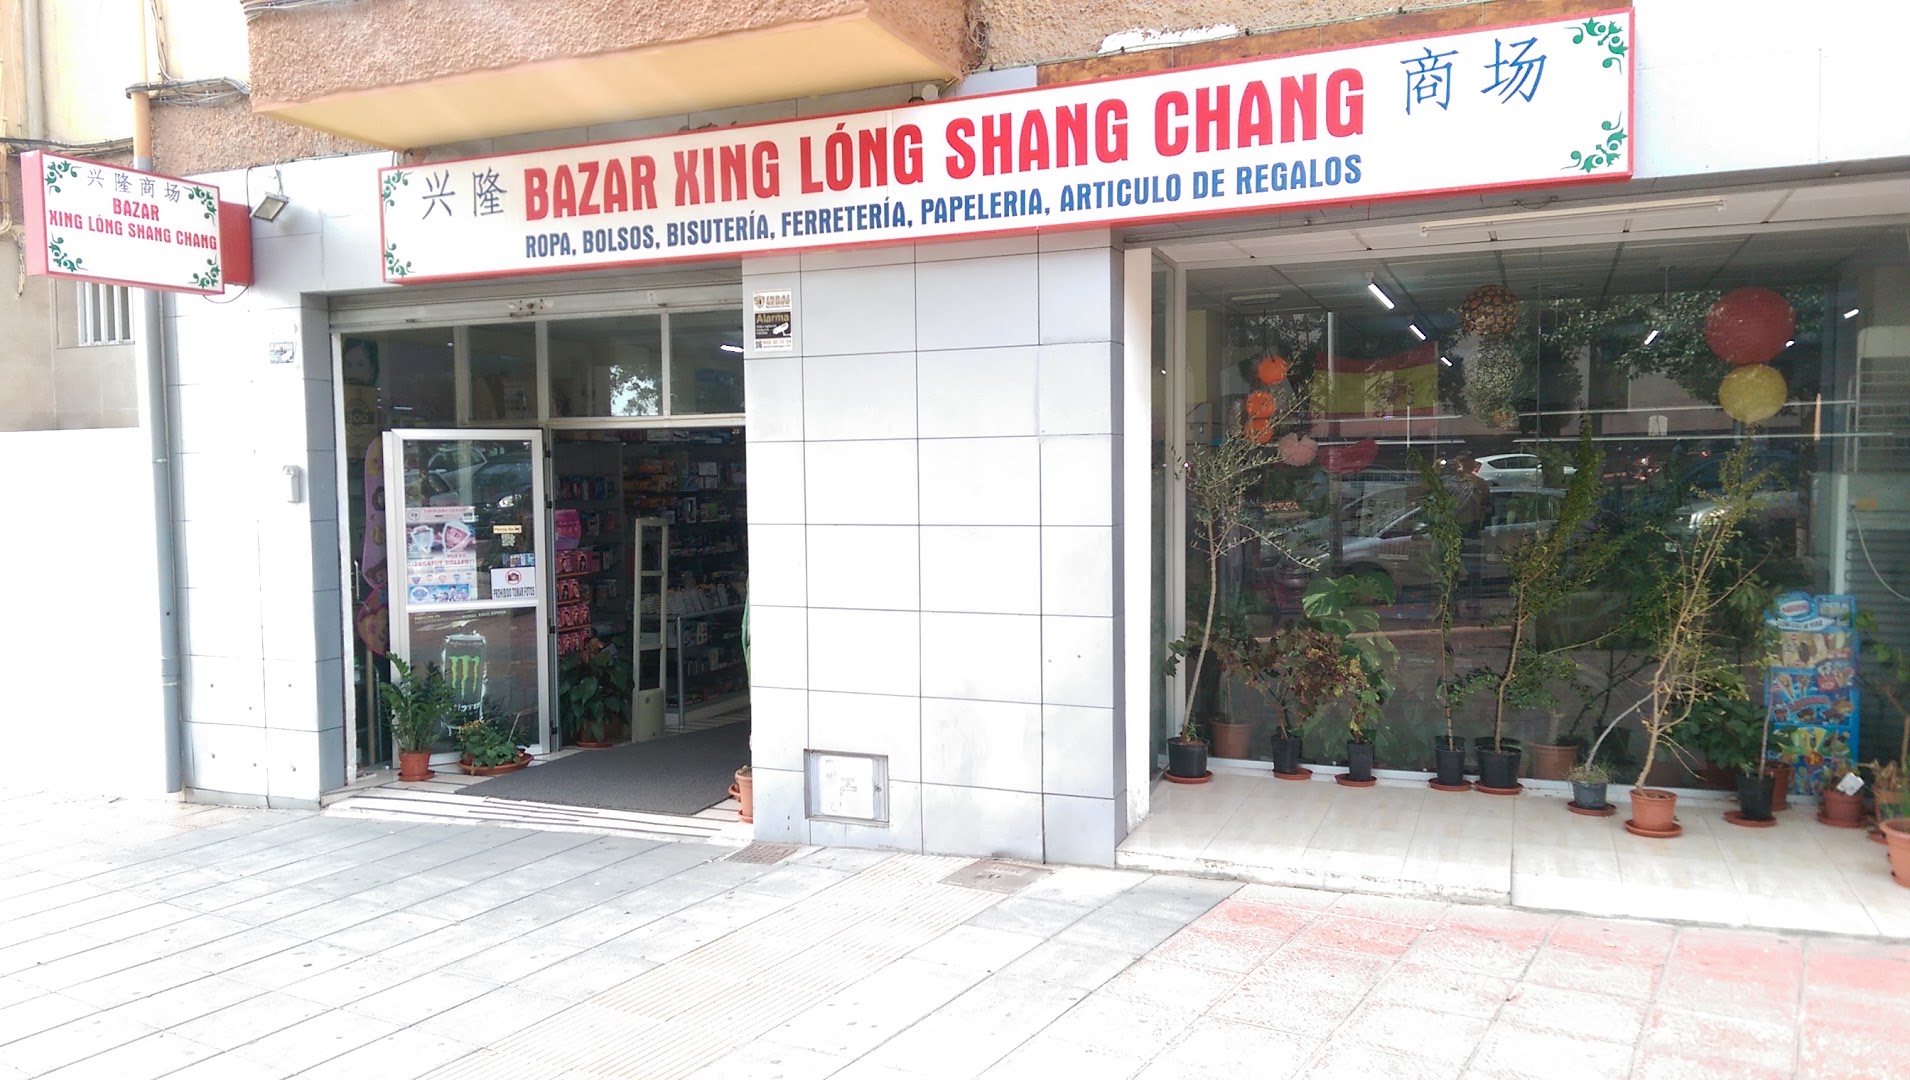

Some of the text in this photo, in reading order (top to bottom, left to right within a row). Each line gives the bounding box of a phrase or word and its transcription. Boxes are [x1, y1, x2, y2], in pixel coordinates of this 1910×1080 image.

[1399, 36, 1548, 116] 商场
[523, 68, 1364, 221] BAZAR XING LÓNG SHANG CHANG
[87, 168, 182, 204] 兴隆商场
[112, 197, 160, 222] BAZAR
[421, 165, 509, 222] 兴隆
[526, 153, 1363, 257] ROPA, BOLSOS, BISUTERÍA, FERRETERÍA, PAPELERIA, ARTICULO DE REGALOS
[49, 209, 218, 250] XING LÓNG SHANG CHANG
[756, 313, 790, 323] Alarma
